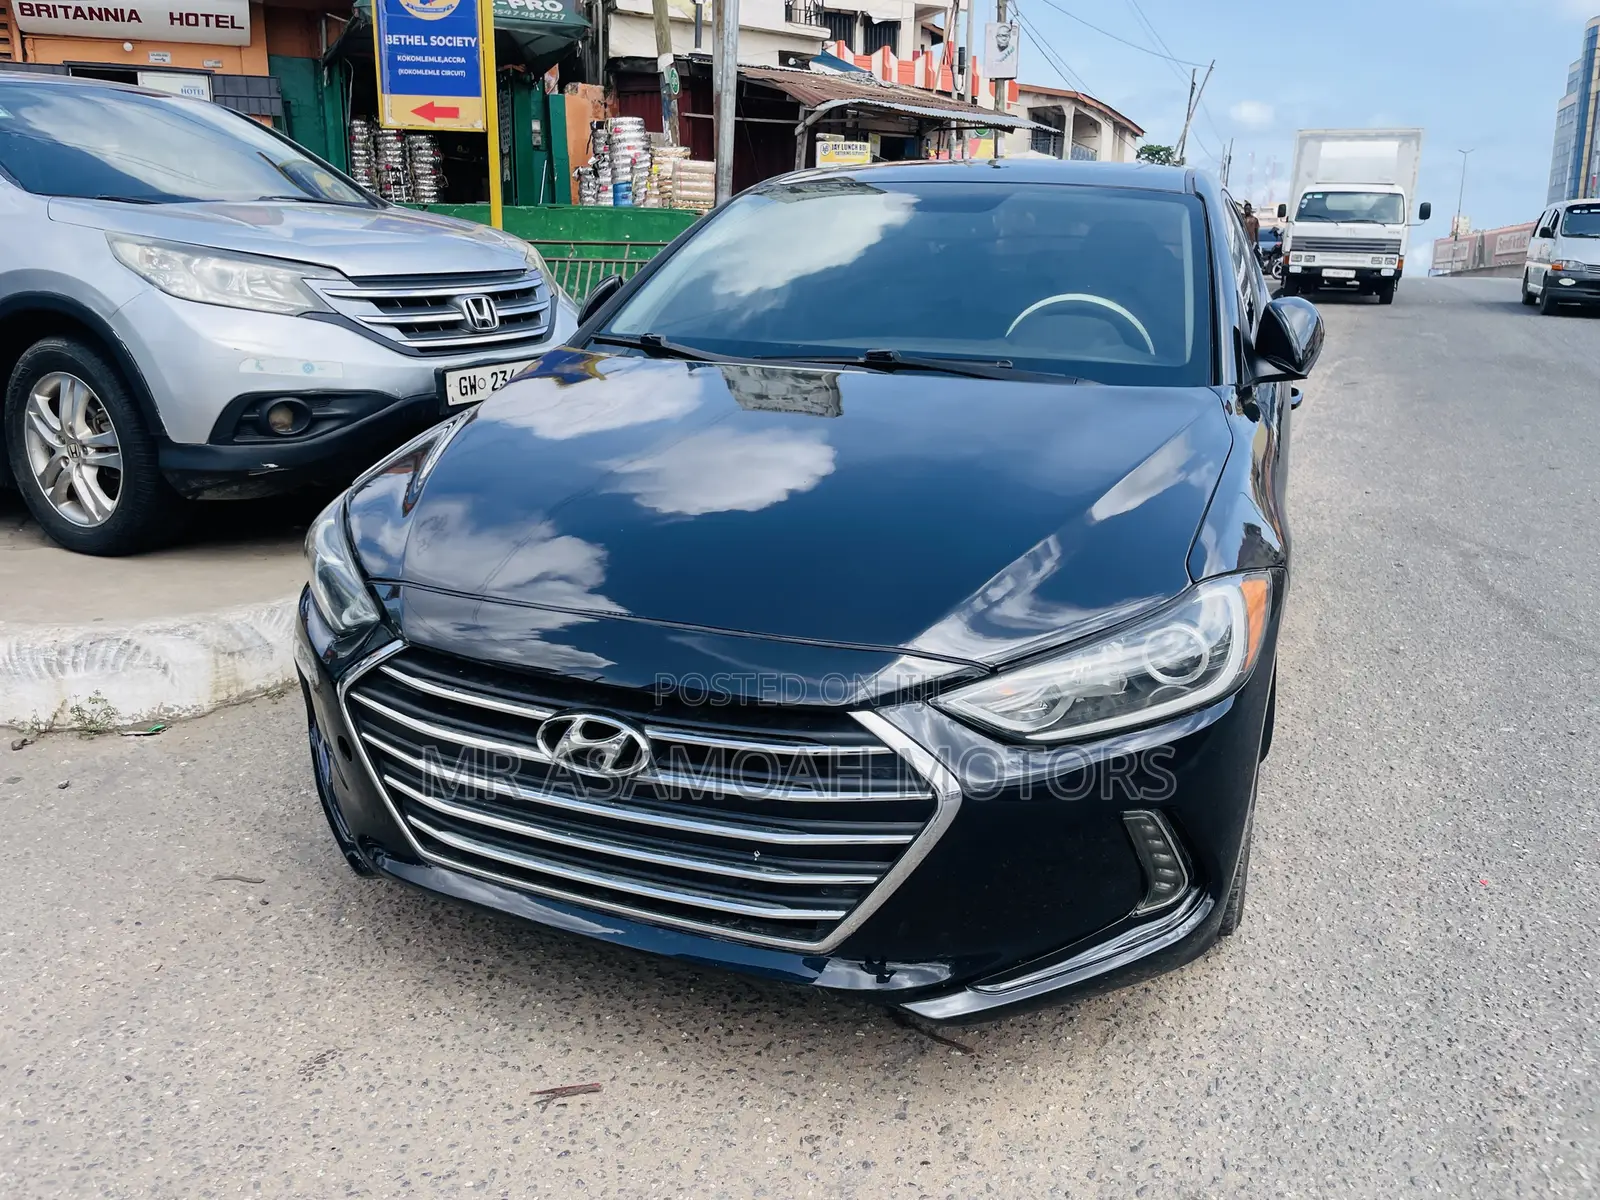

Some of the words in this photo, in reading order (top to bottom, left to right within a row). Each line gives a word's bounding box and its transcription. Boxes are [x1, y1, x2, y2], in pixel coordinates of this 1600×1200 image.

[18, 2, 143, 24] BRITANNIA
[168, 11, 245, 30] HOTEL
[385, 34, 428, 46] BETHEL
[430, 35, 477, 48] SOCIETY
[180, 87, 205, 96] HOTEL
[458, 374, 478, 397] GW
